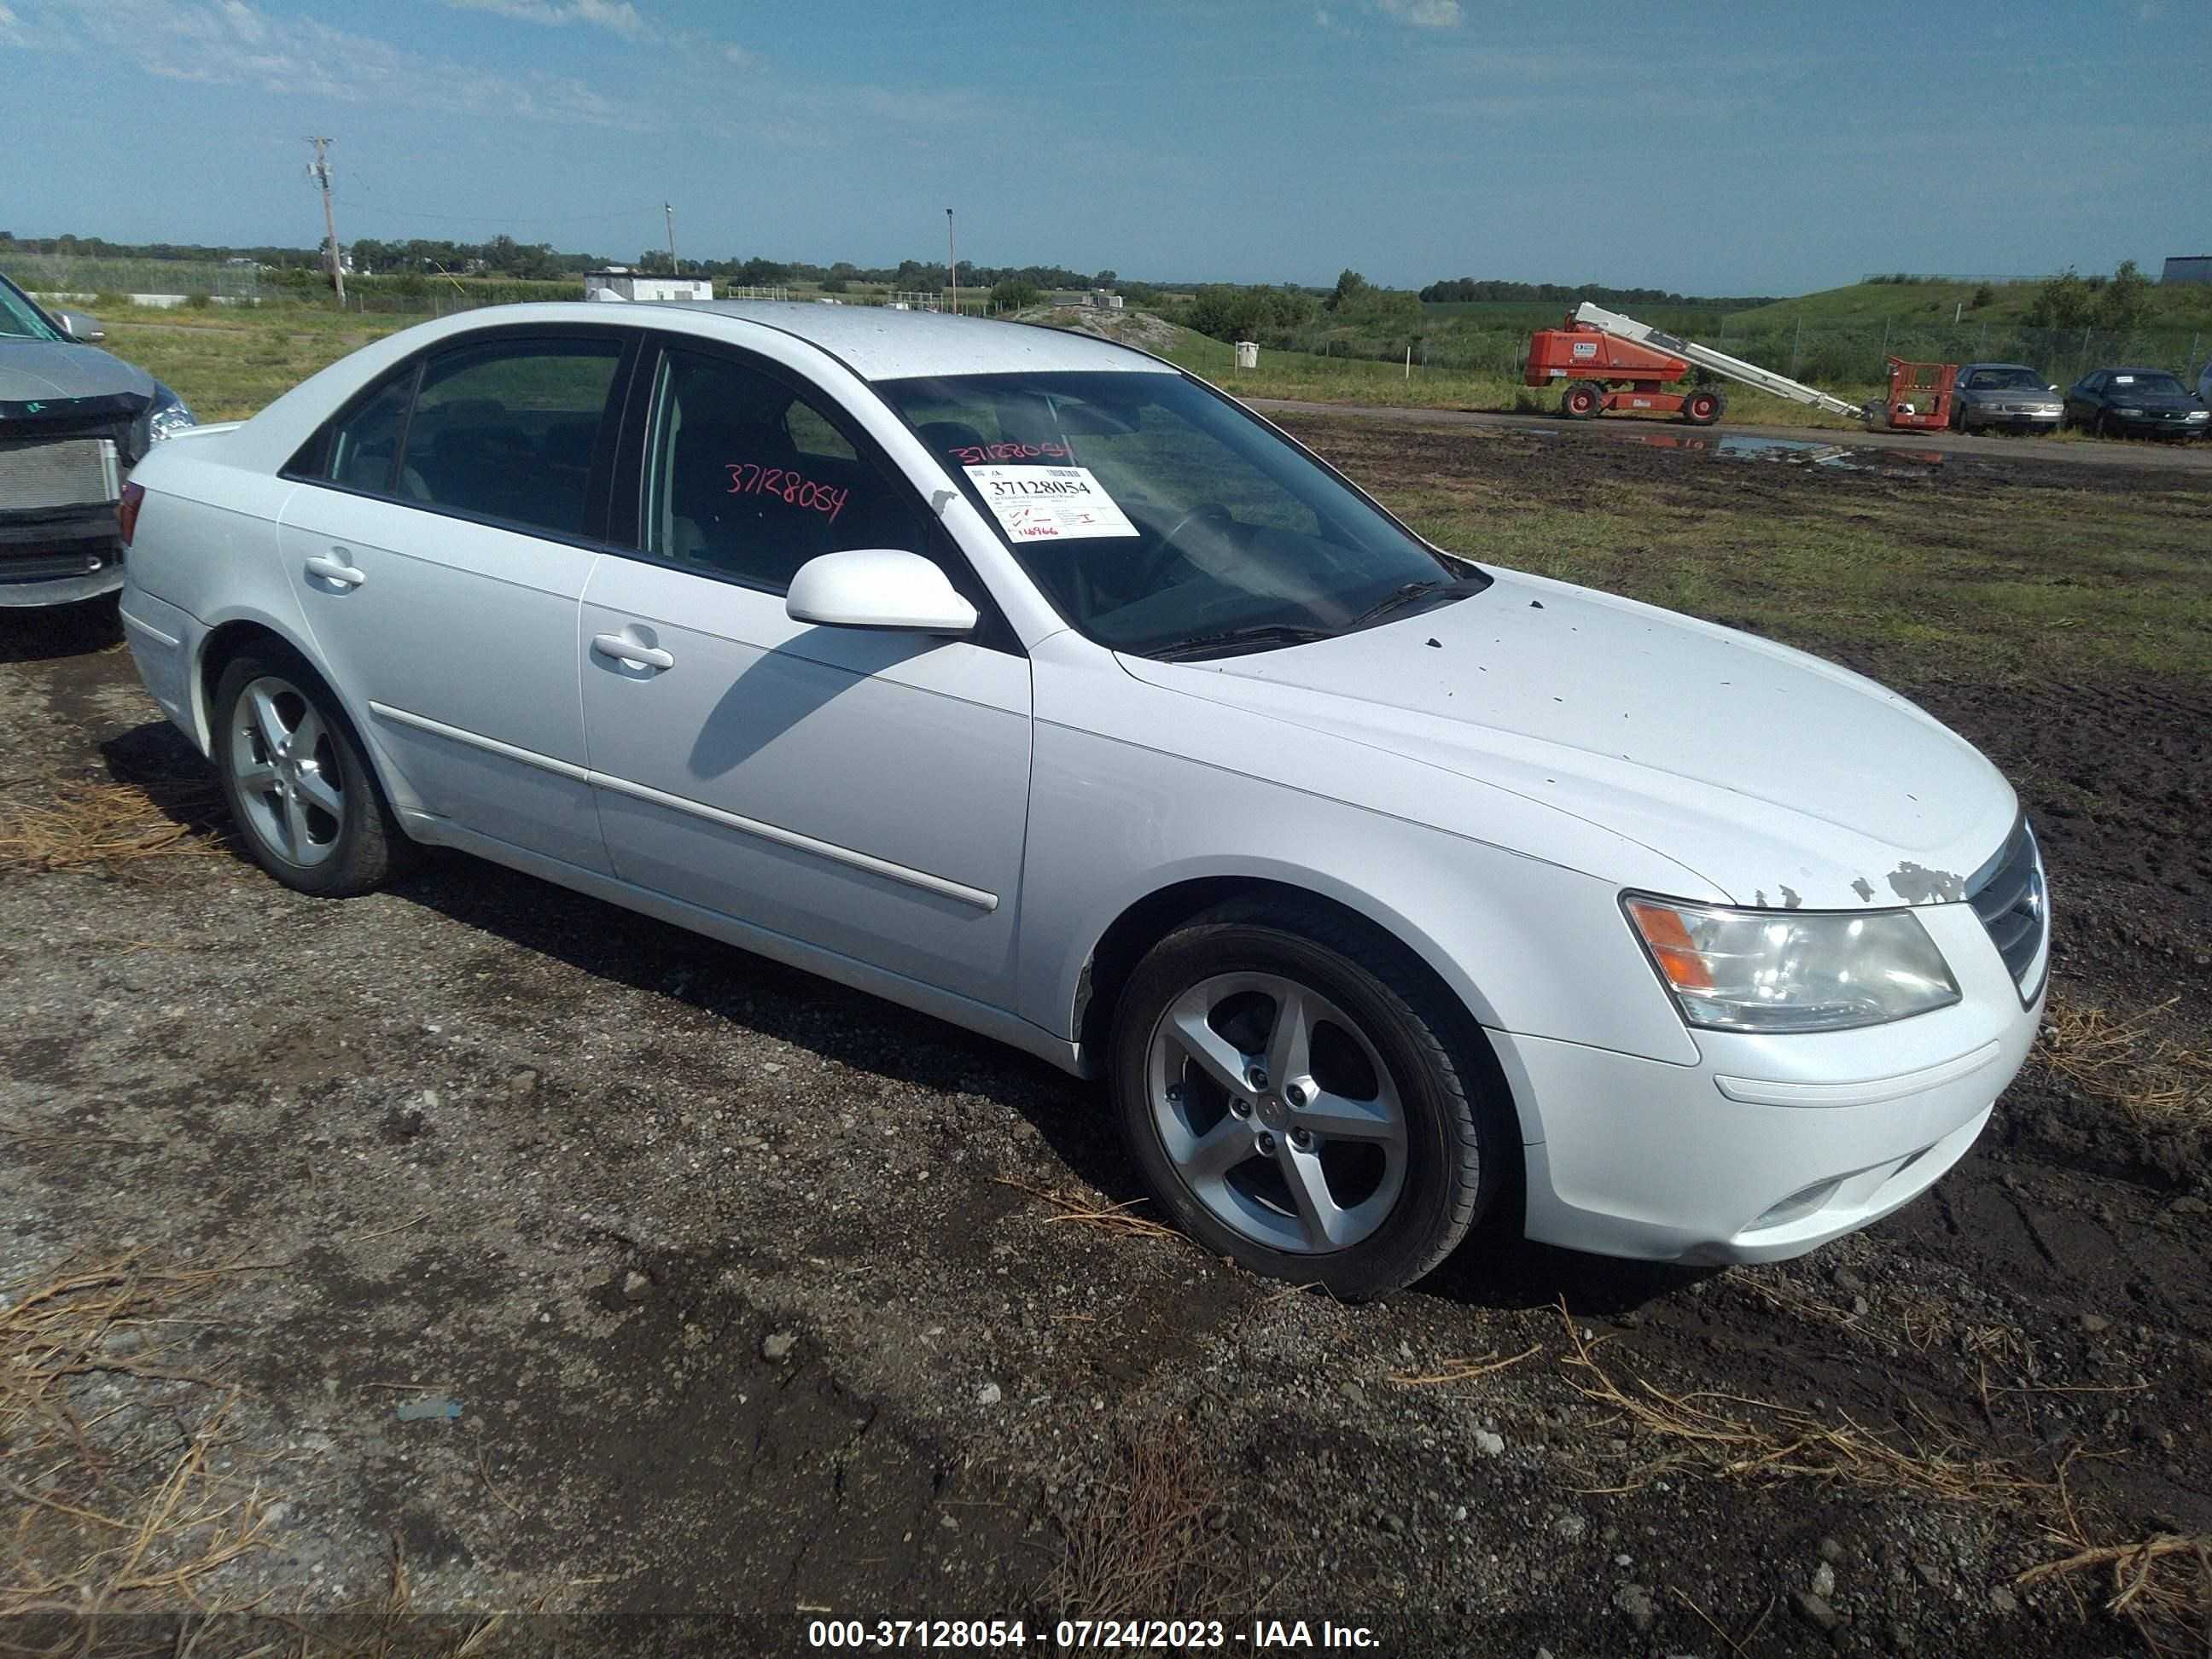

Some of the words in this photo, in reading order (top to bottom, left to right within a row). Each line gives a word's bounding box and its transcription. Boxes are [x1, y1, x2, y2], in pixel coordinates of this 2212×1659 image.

[948, 442, 1072, 463] 37128054
[725, 463, 848, 524] 37128054
[989, 480, 1091, 496] 37128054
